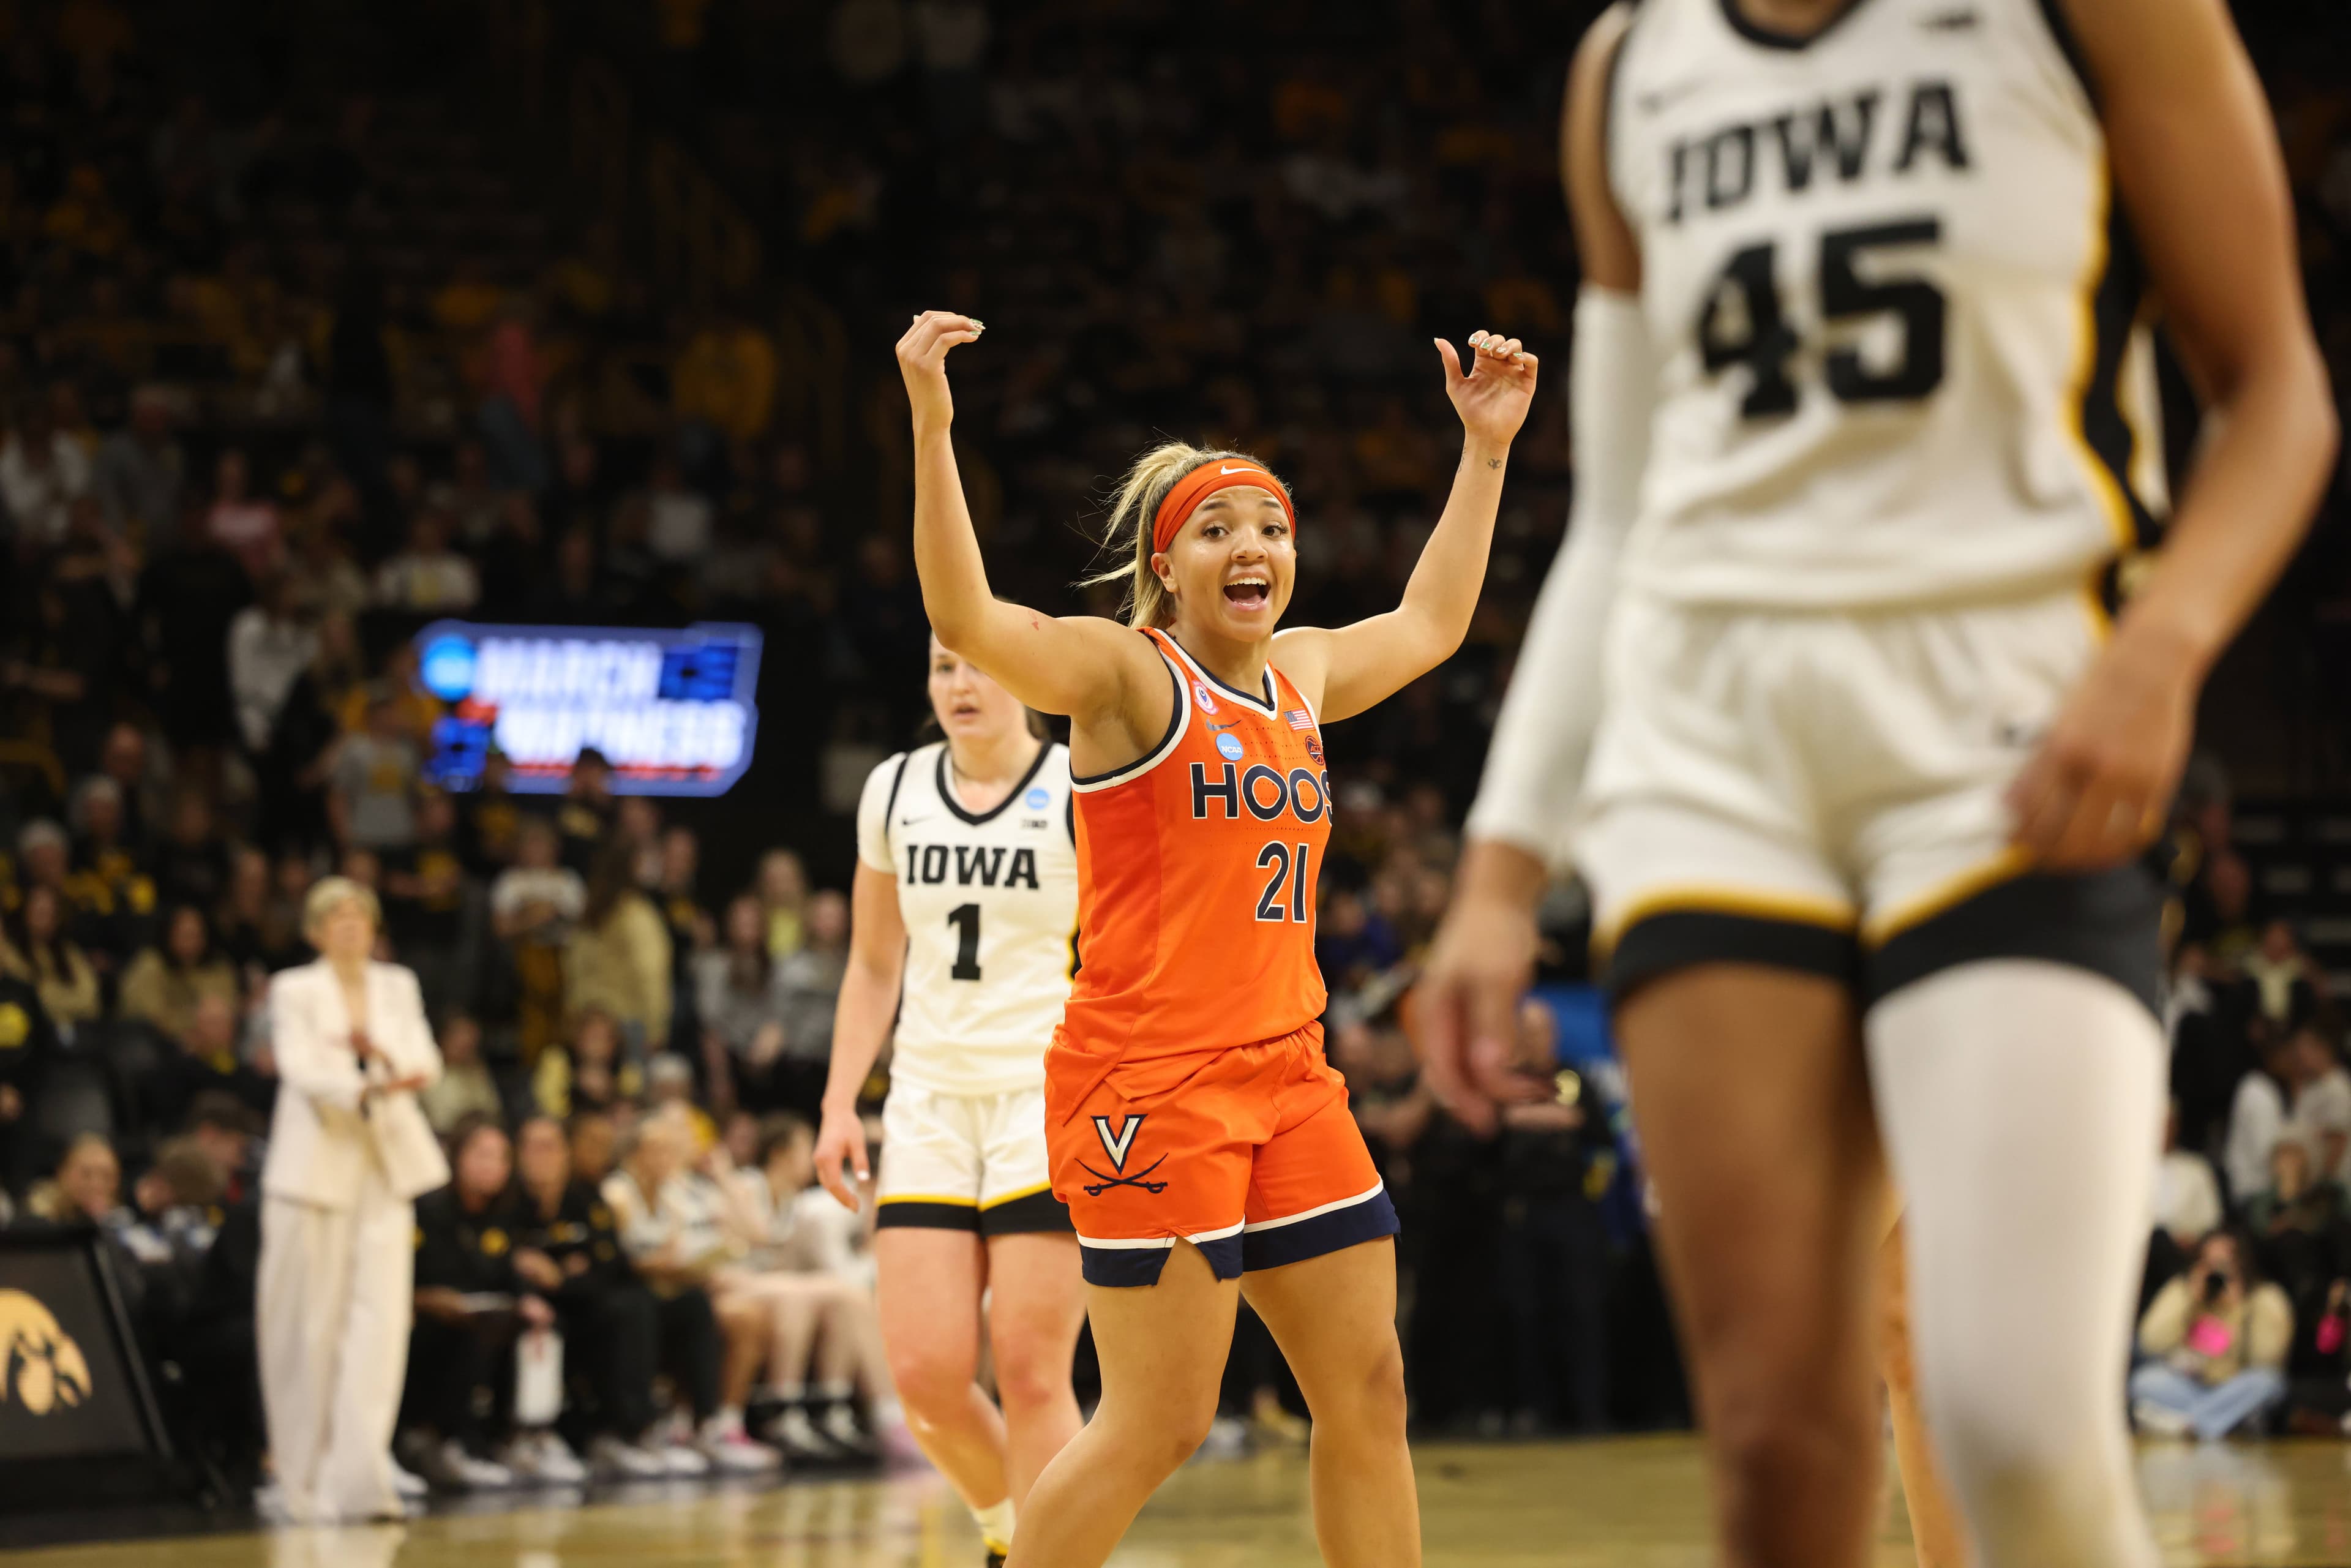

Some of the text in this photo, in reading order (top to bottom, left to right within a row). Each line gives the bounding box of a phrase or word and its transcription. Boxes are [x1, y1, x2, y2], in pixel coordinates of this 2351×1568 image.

[1663, 80, 1973, 227] IOWA
[1698, 217, 1946, 421] 45
[1221, 745, 1243, 754] NCAA
[906, 844, 1040, 890] IOWA
[1254, 840, 1309, 924] 21
[947, 902, 982, 980] 1
